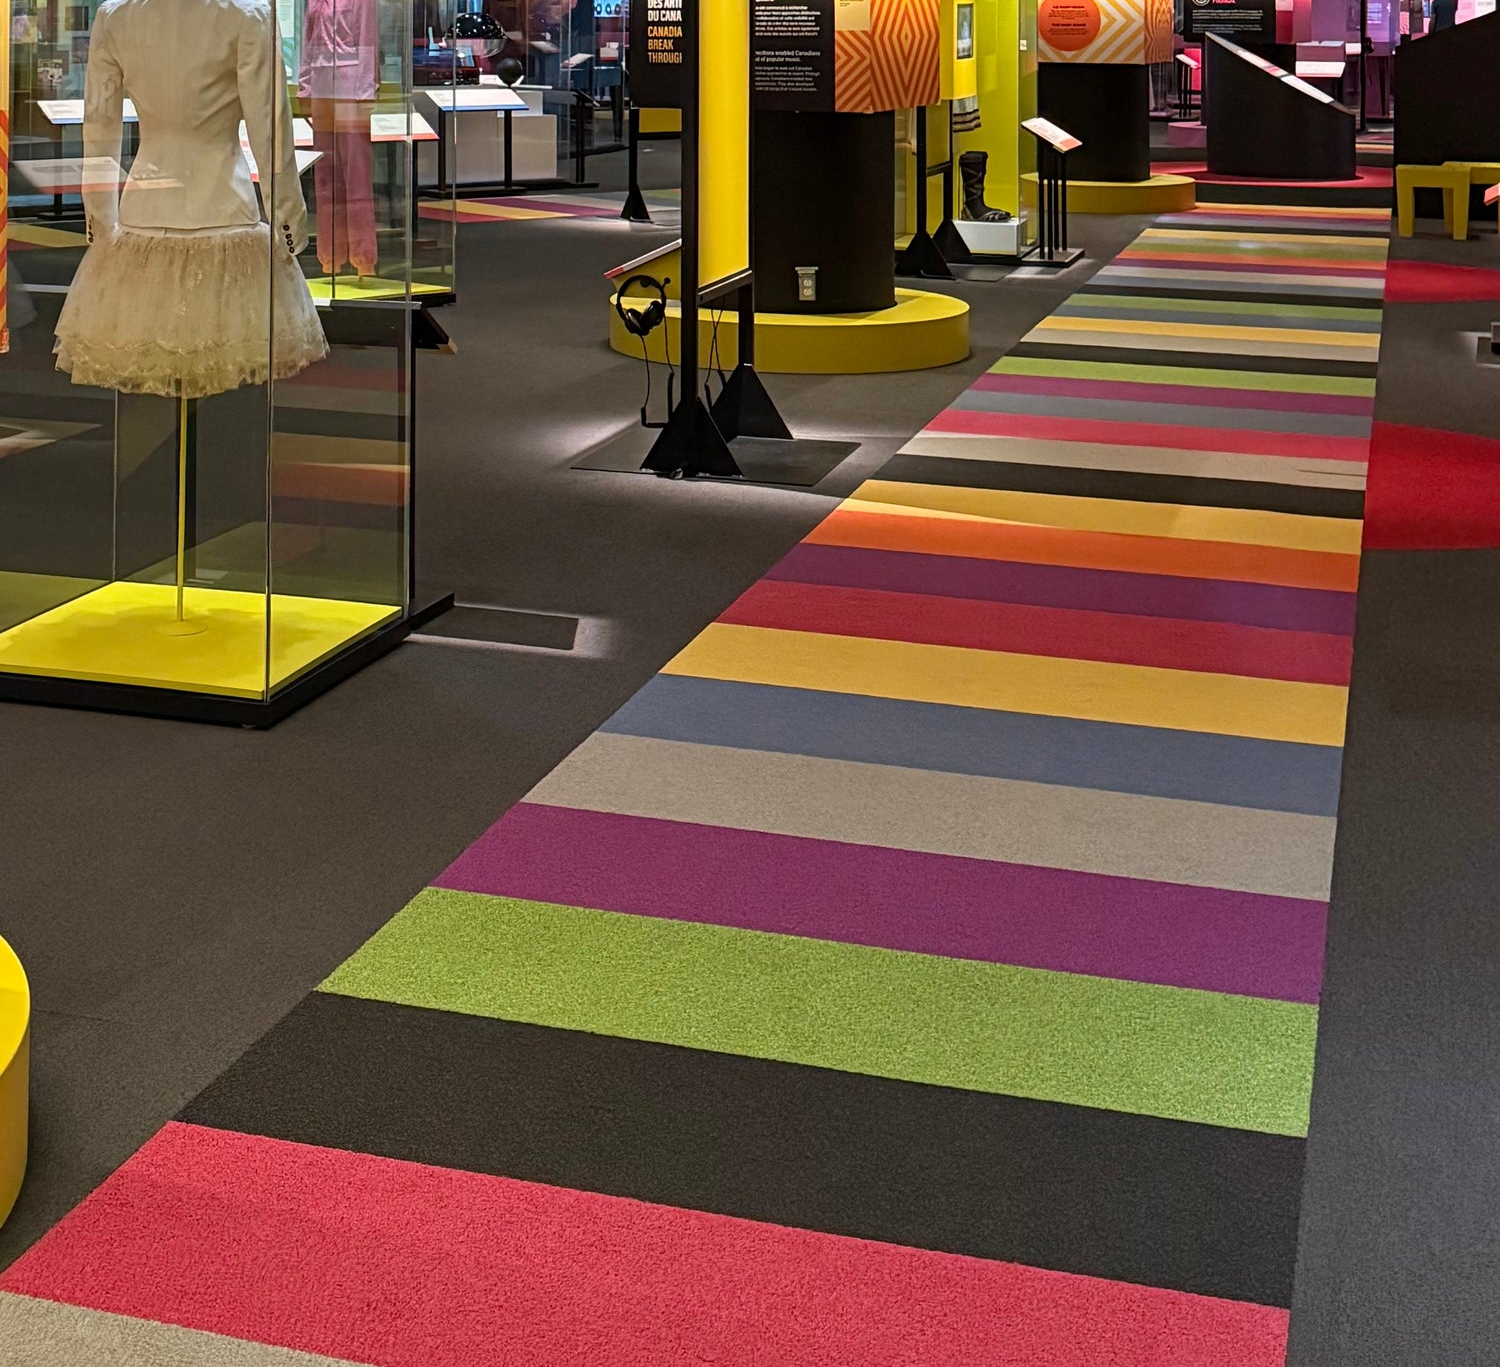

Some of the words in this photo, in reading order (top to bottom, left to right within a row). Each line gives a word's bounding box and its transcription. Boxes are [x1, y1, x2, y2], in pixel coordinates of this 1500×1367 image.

[647, 10, 659, 22] DU
[660, 10, 682, 22] CANA
[647, 26, 683, 37] CANADIA
[647, 39, 674, 50] BREAK
